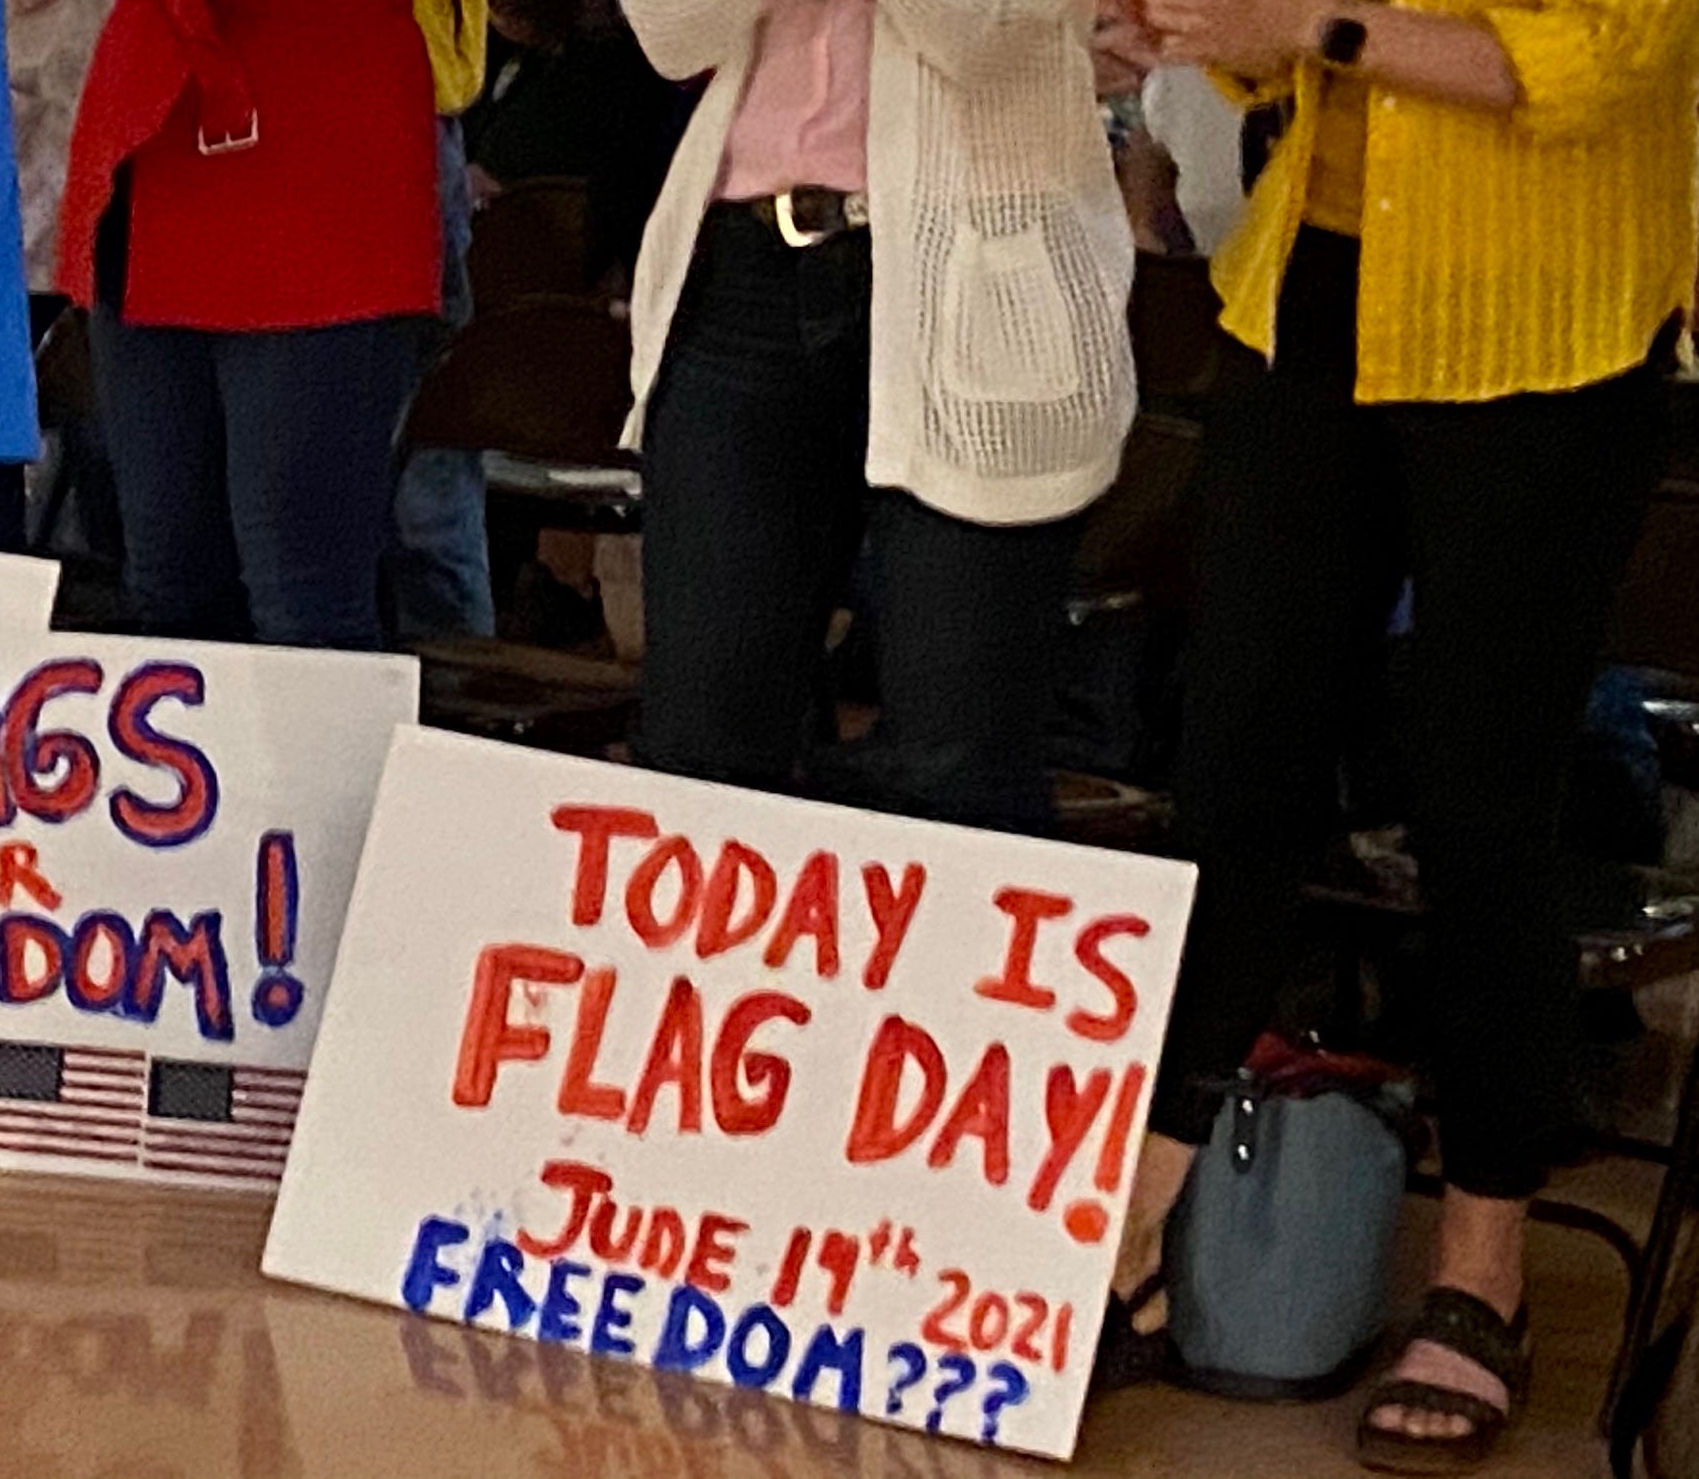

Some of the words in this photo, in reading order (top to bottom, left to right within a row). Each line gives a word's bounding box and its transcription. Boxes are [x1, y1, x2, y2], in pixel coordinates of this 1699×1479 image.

[550, 803, 927, 991] TODAY
[974, 885, 1150, 1043] IS
[451, 943, 812, 1135] FLAG
[845, 1012, 1146, 1244] DAY!
[921, 1268, 1074, 1375] 2021
